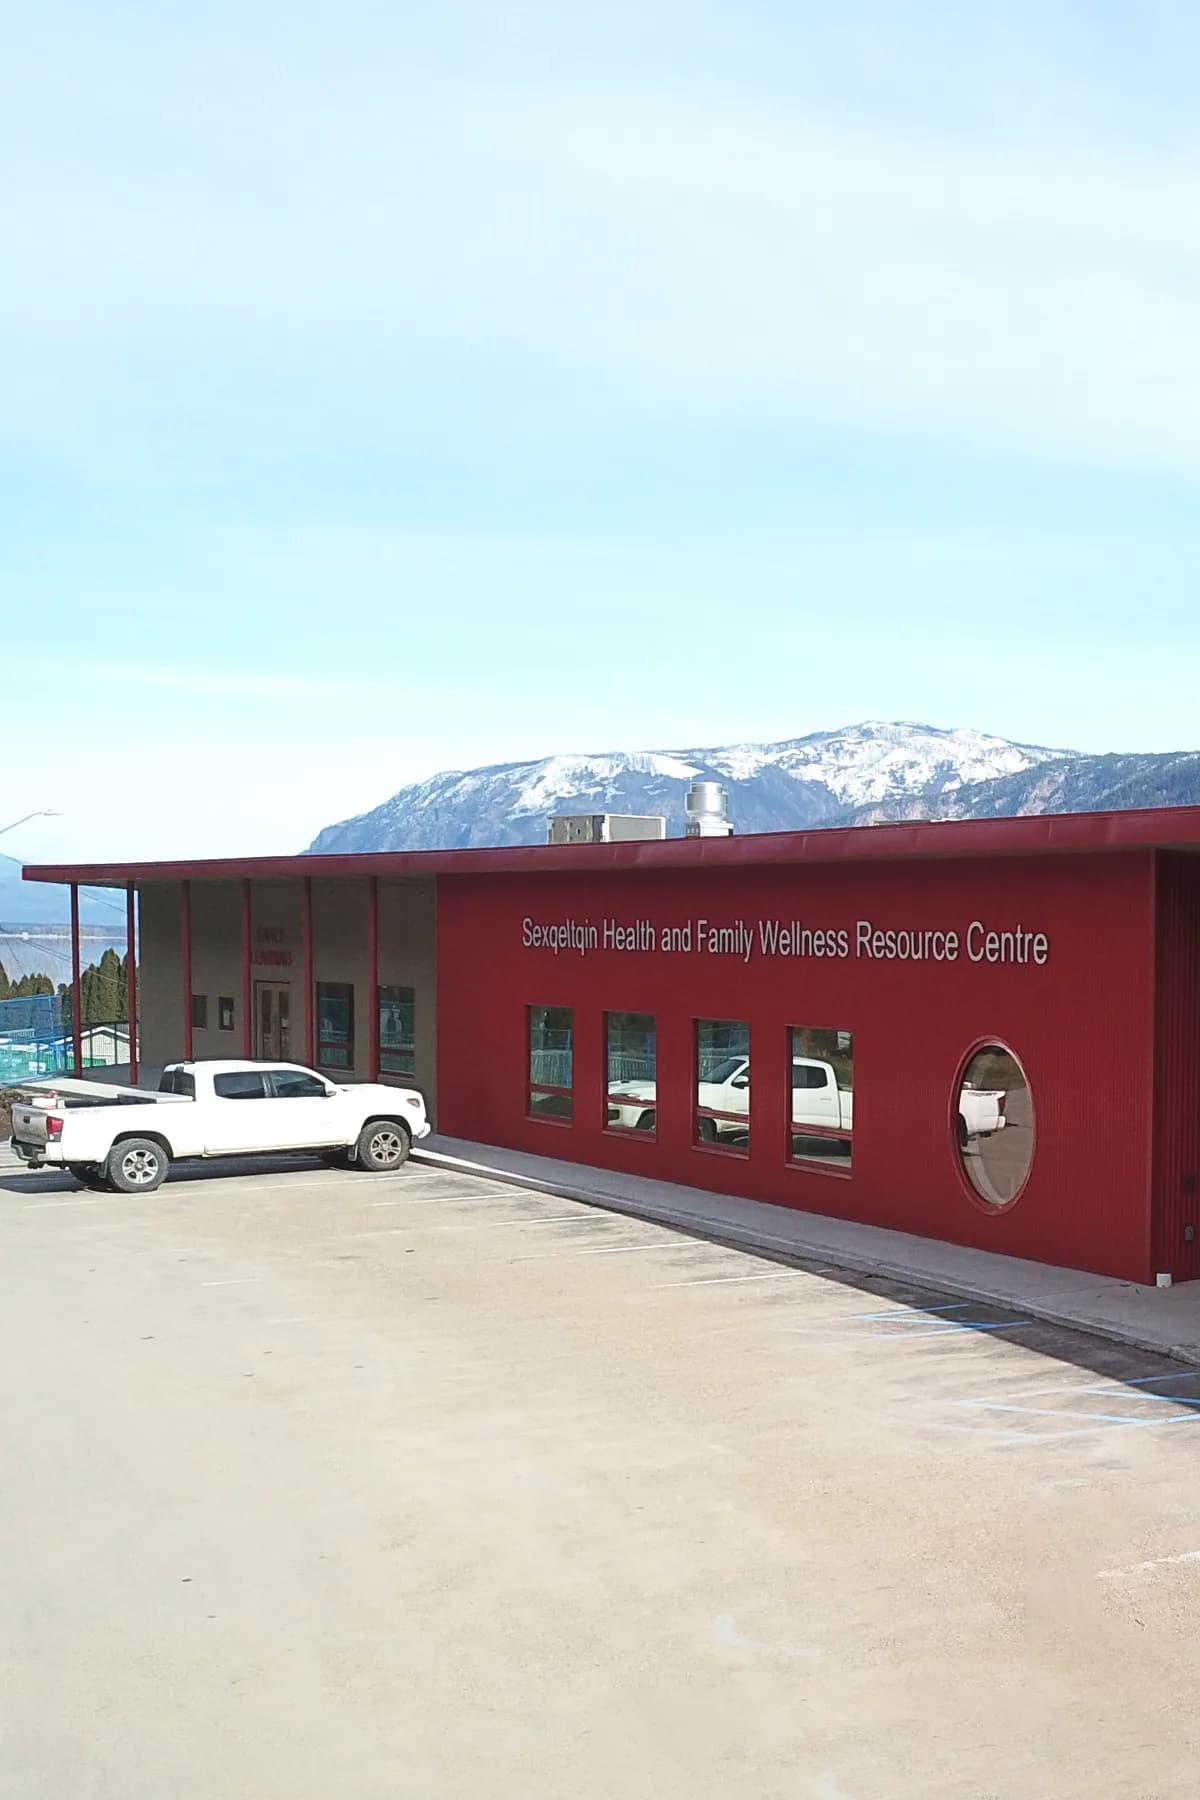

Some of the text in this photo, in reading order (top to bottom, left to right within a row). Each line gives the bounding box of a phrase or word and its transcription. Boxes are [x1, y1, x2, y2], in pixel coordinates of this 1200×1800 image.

[522, 917, 1048, 965] Sexqeltqin Health and Family Wellness Resource Centre
